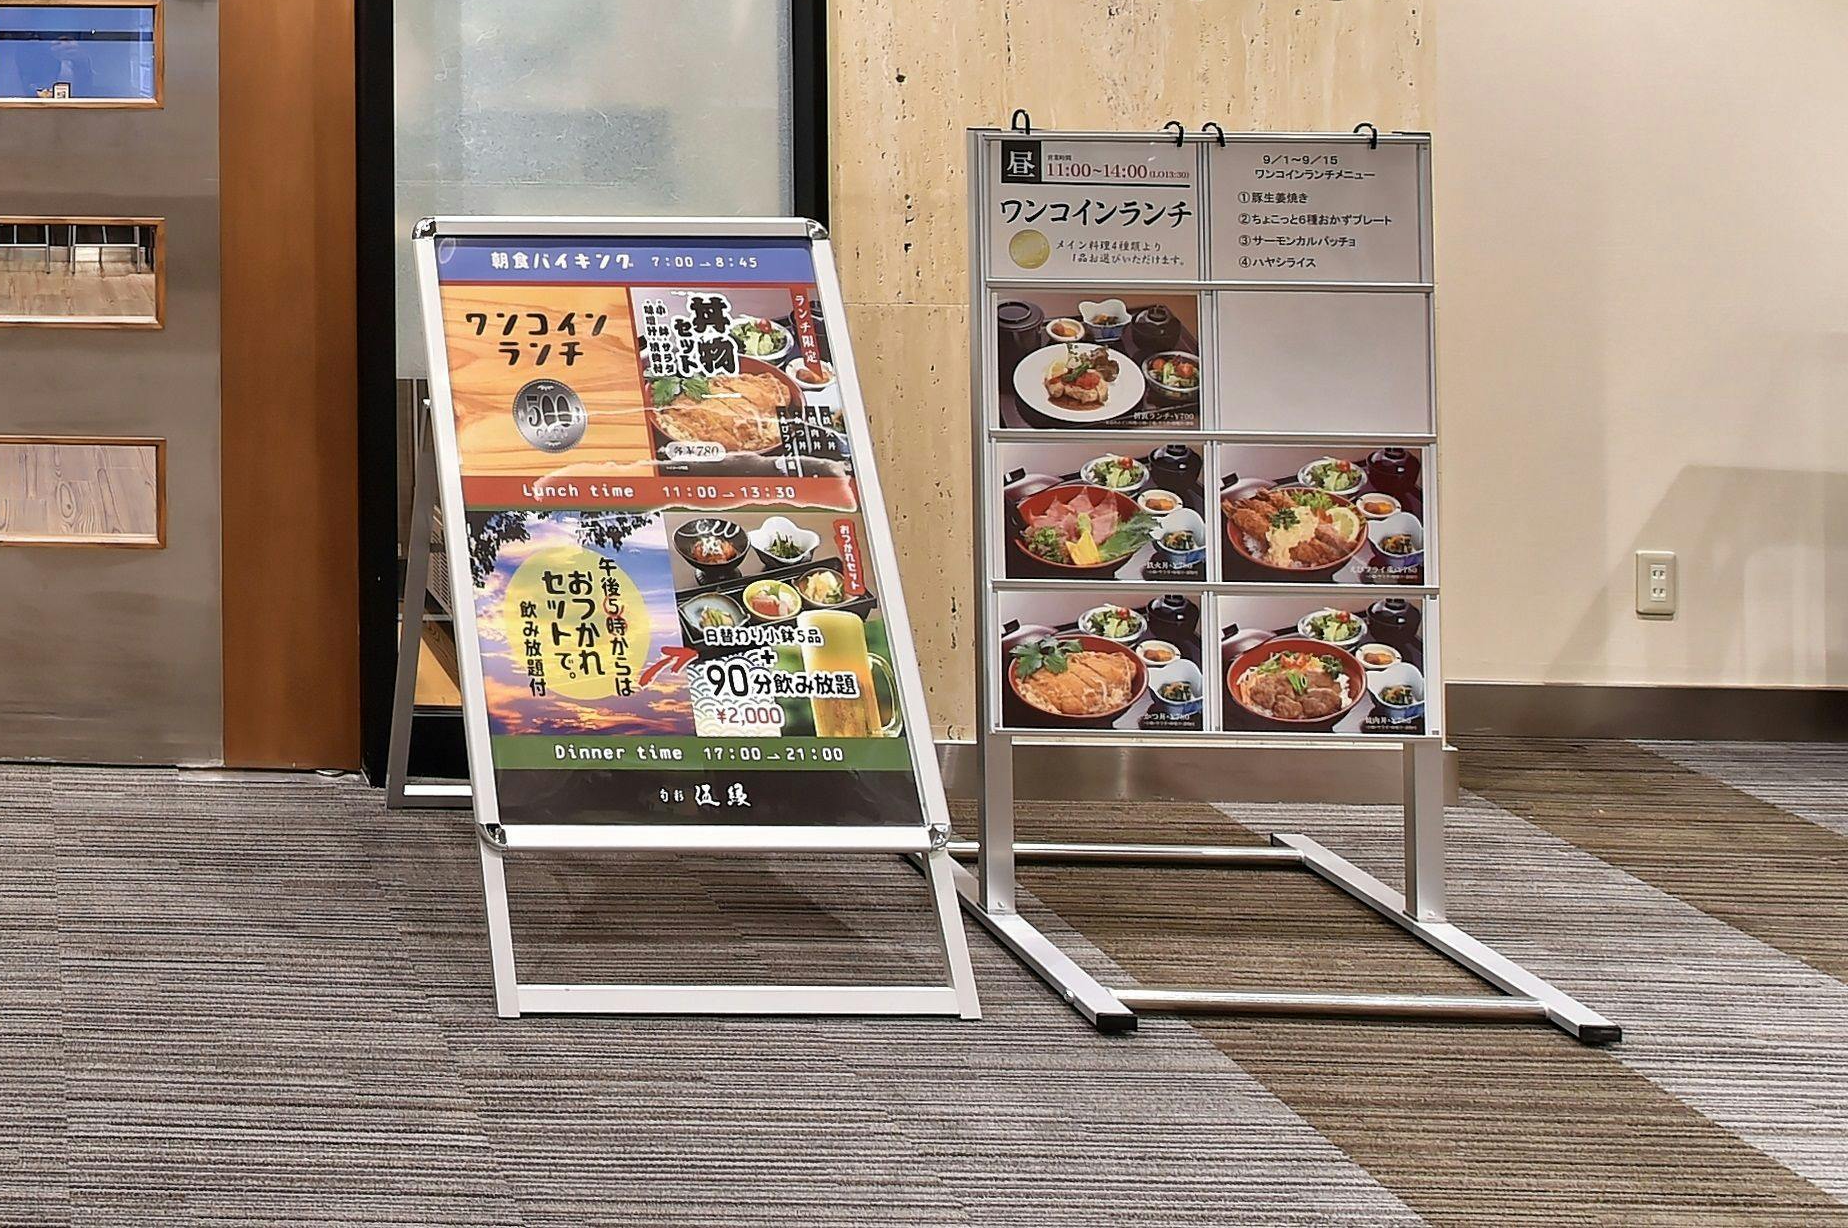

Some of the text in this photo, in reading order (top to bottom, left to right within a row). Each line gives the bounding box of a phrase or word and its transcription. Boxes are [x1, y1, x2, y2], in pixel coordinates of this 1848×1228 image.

[1006, 150, 1035, 178] 昼
[1254, 169, 1376, 180] ワンコインランチメニュー
[1000, 198, 1193, 228] ワンコインランチ
[490, 251, 634, 270] 朝食バイキング
[466, 312, 607, 337] ワンコイン
[690, 297, 735, 373] 丼物
[795, 295, 818, 363] ランチ限定
[498, 341, 584, 367] ランチ
[674, 319, 699, 373] セット
[523, 483, 579, 497] Lunch
[590, 483, 635, 497] time
[568, 570, 606, 675] おつかれ
[599, 557, 635, 697] 午後5時からは
[706, 628, 822, 644] 日替わり小鉢5品
[520, 600, 546, 697] 飲み放題付
[716, 707, 782, 726] ¥2,000
[554, 744, 626, 760] Dinner
[637, 744, 684, 760] time
